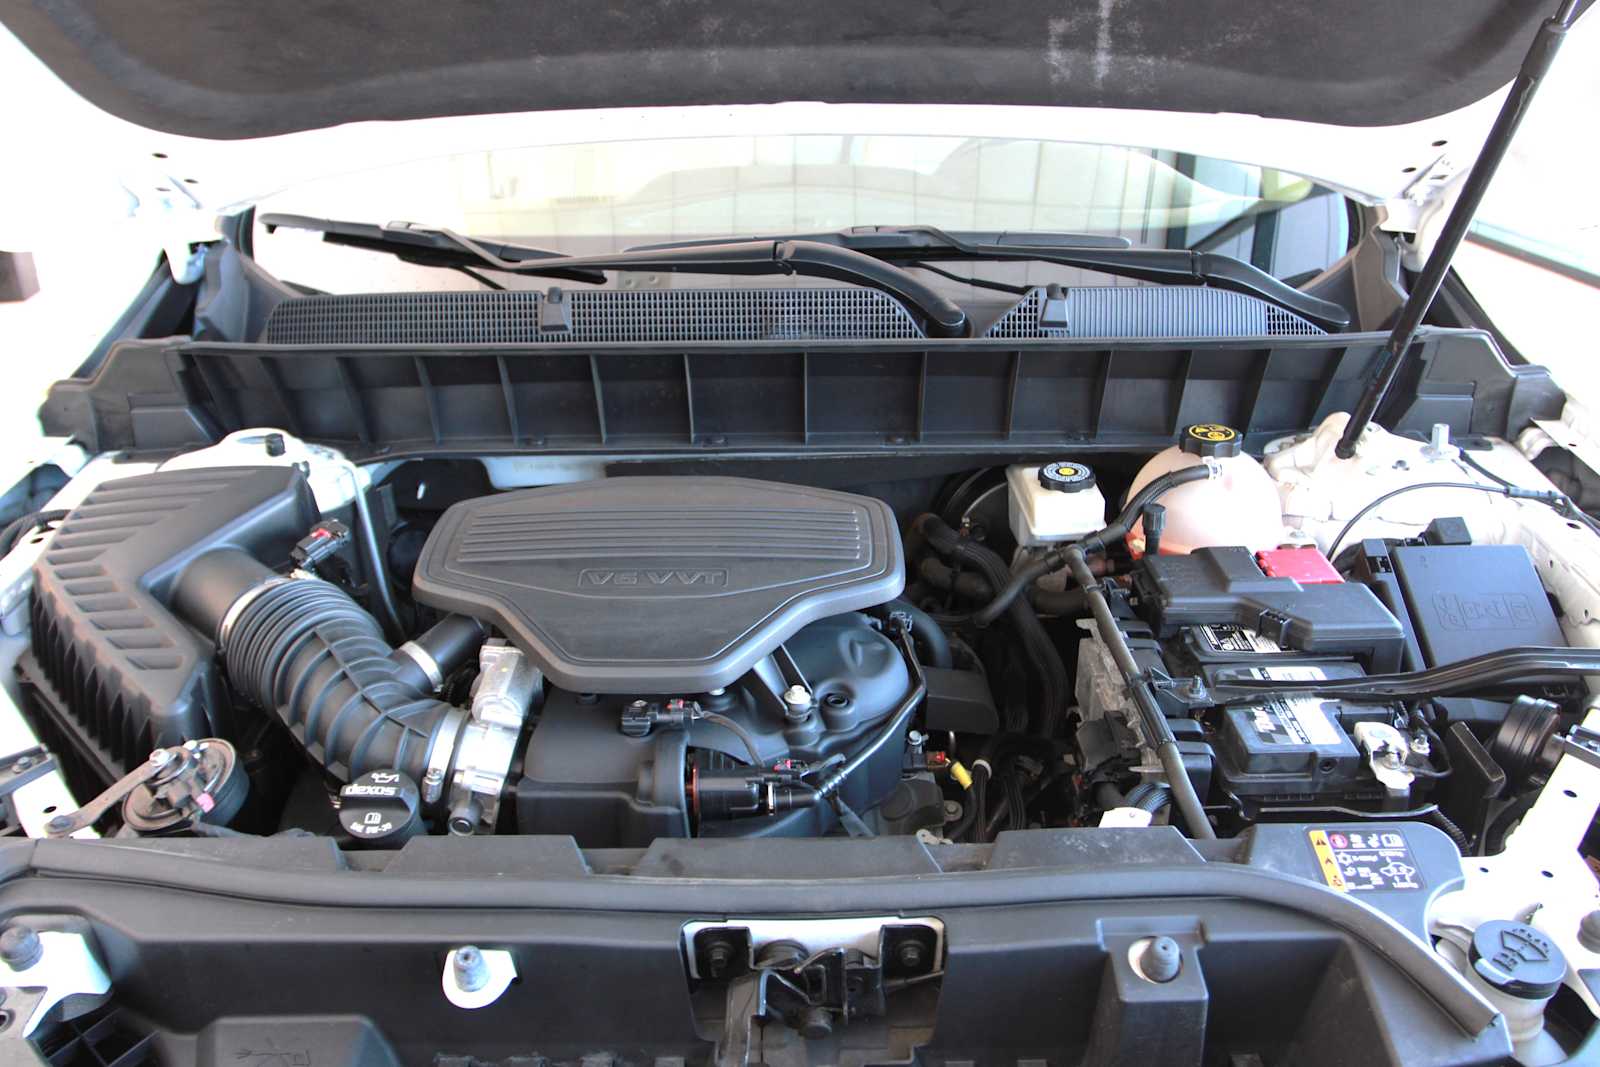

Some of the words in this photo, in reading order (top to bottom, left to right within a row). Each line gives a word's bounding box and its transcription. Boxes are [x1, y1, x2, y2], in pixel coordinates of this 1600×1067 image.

[586, 571, 639, 585] V6
[646, 571, 724, 585] VVT
[345, 784, 397, 795] dexos
